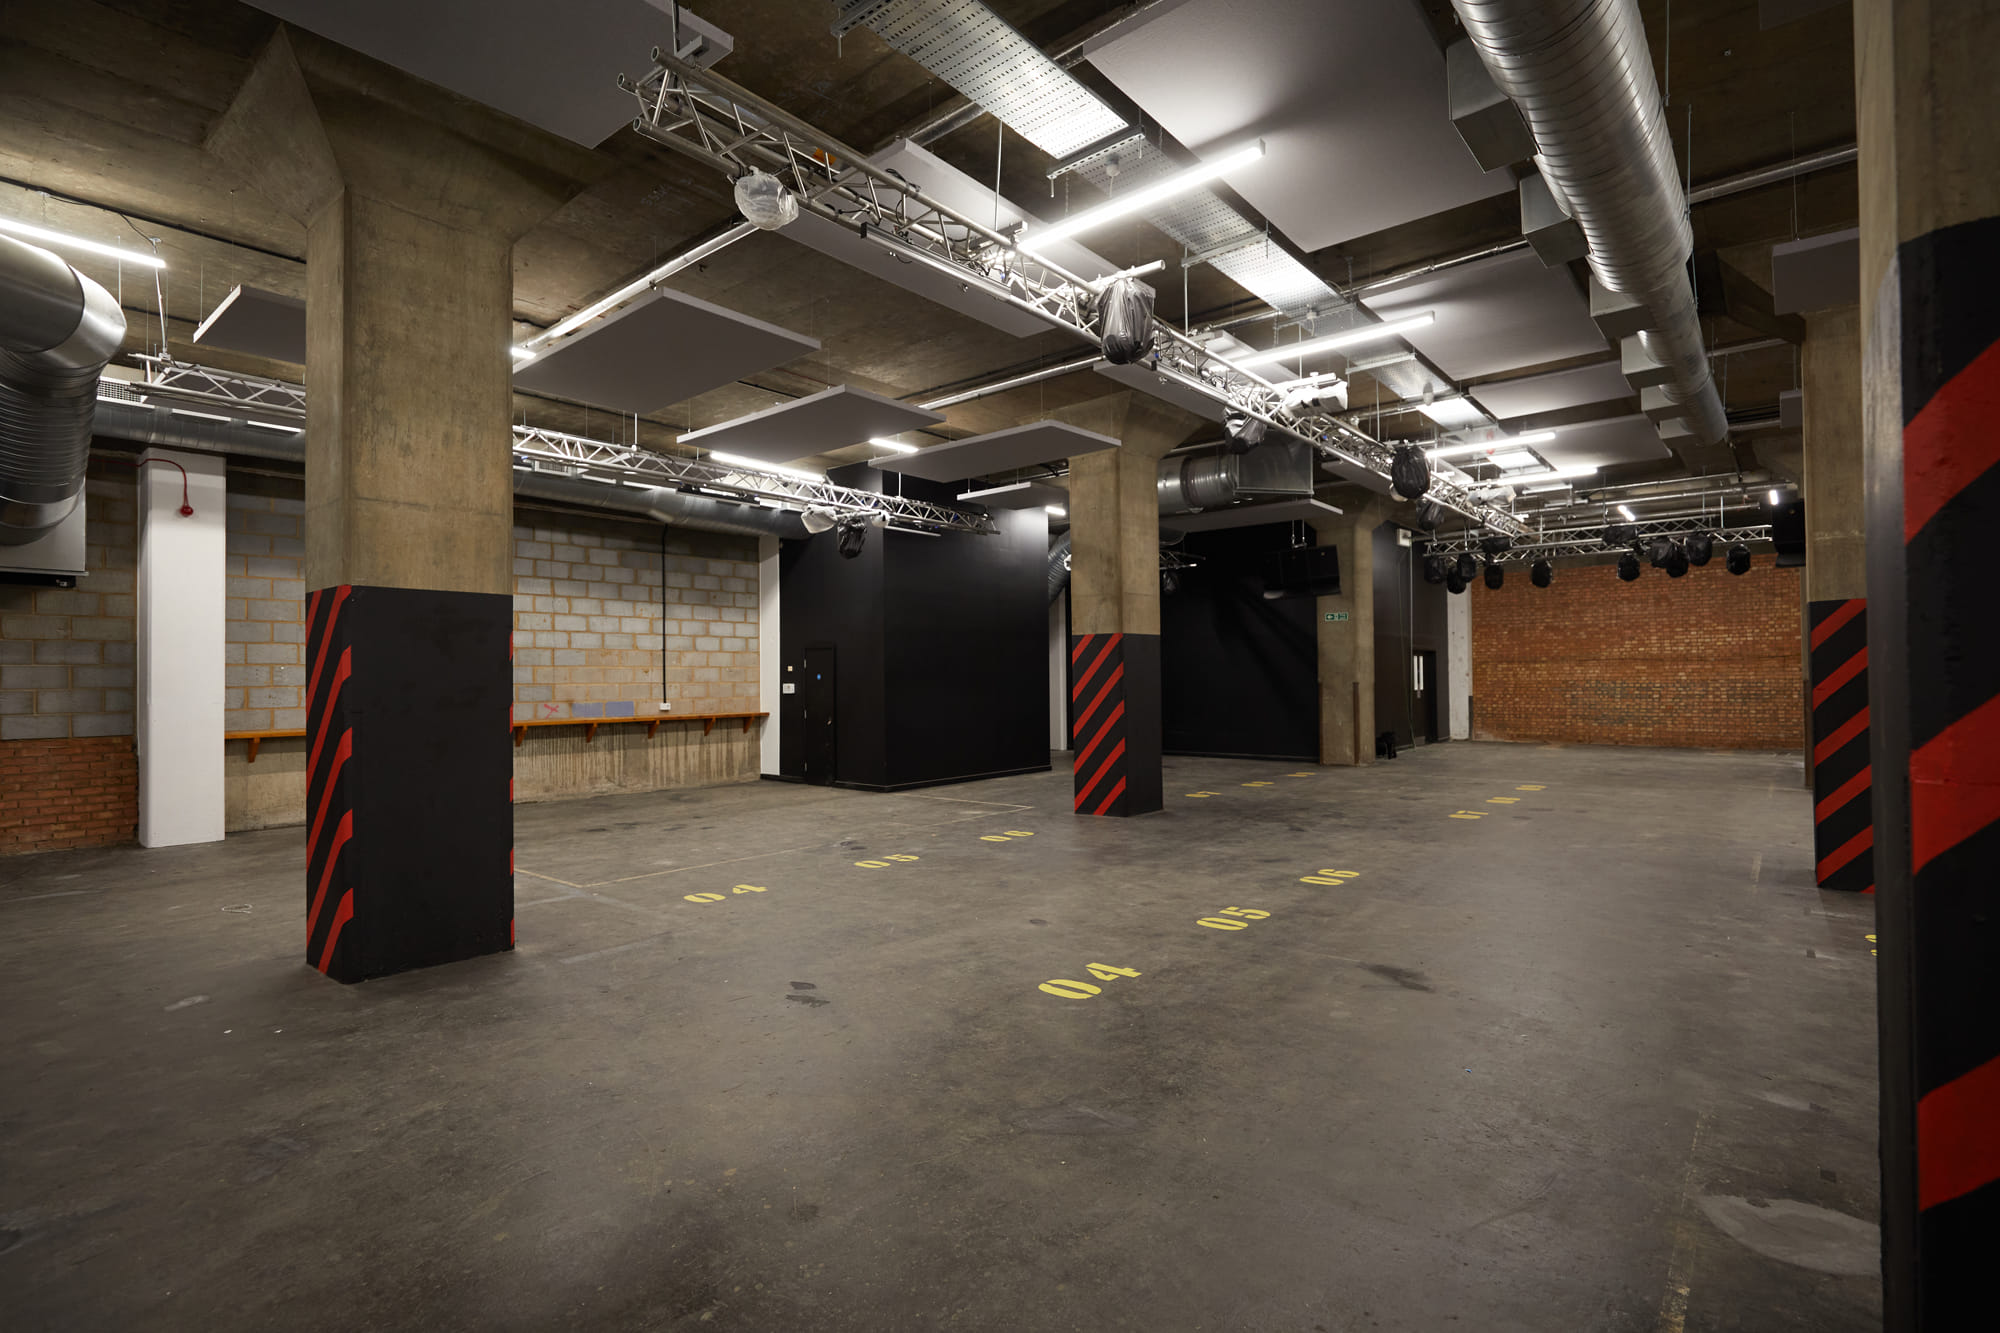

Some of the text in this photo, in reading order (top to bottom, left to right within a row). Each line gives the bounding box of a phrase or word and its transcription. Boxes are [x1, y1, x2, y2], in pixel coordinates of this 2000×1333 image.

[1448, 810, 1489, 819] 07
[979, 830, 1035, 842] 06
[854, 854, 920, 868] 05
[1299, 868, 1361, 886] 06
[683, 883, 768, 903] 04
[1196, 906, 1271, 931] 05
[1038, 962, 1142, 1000] 04
